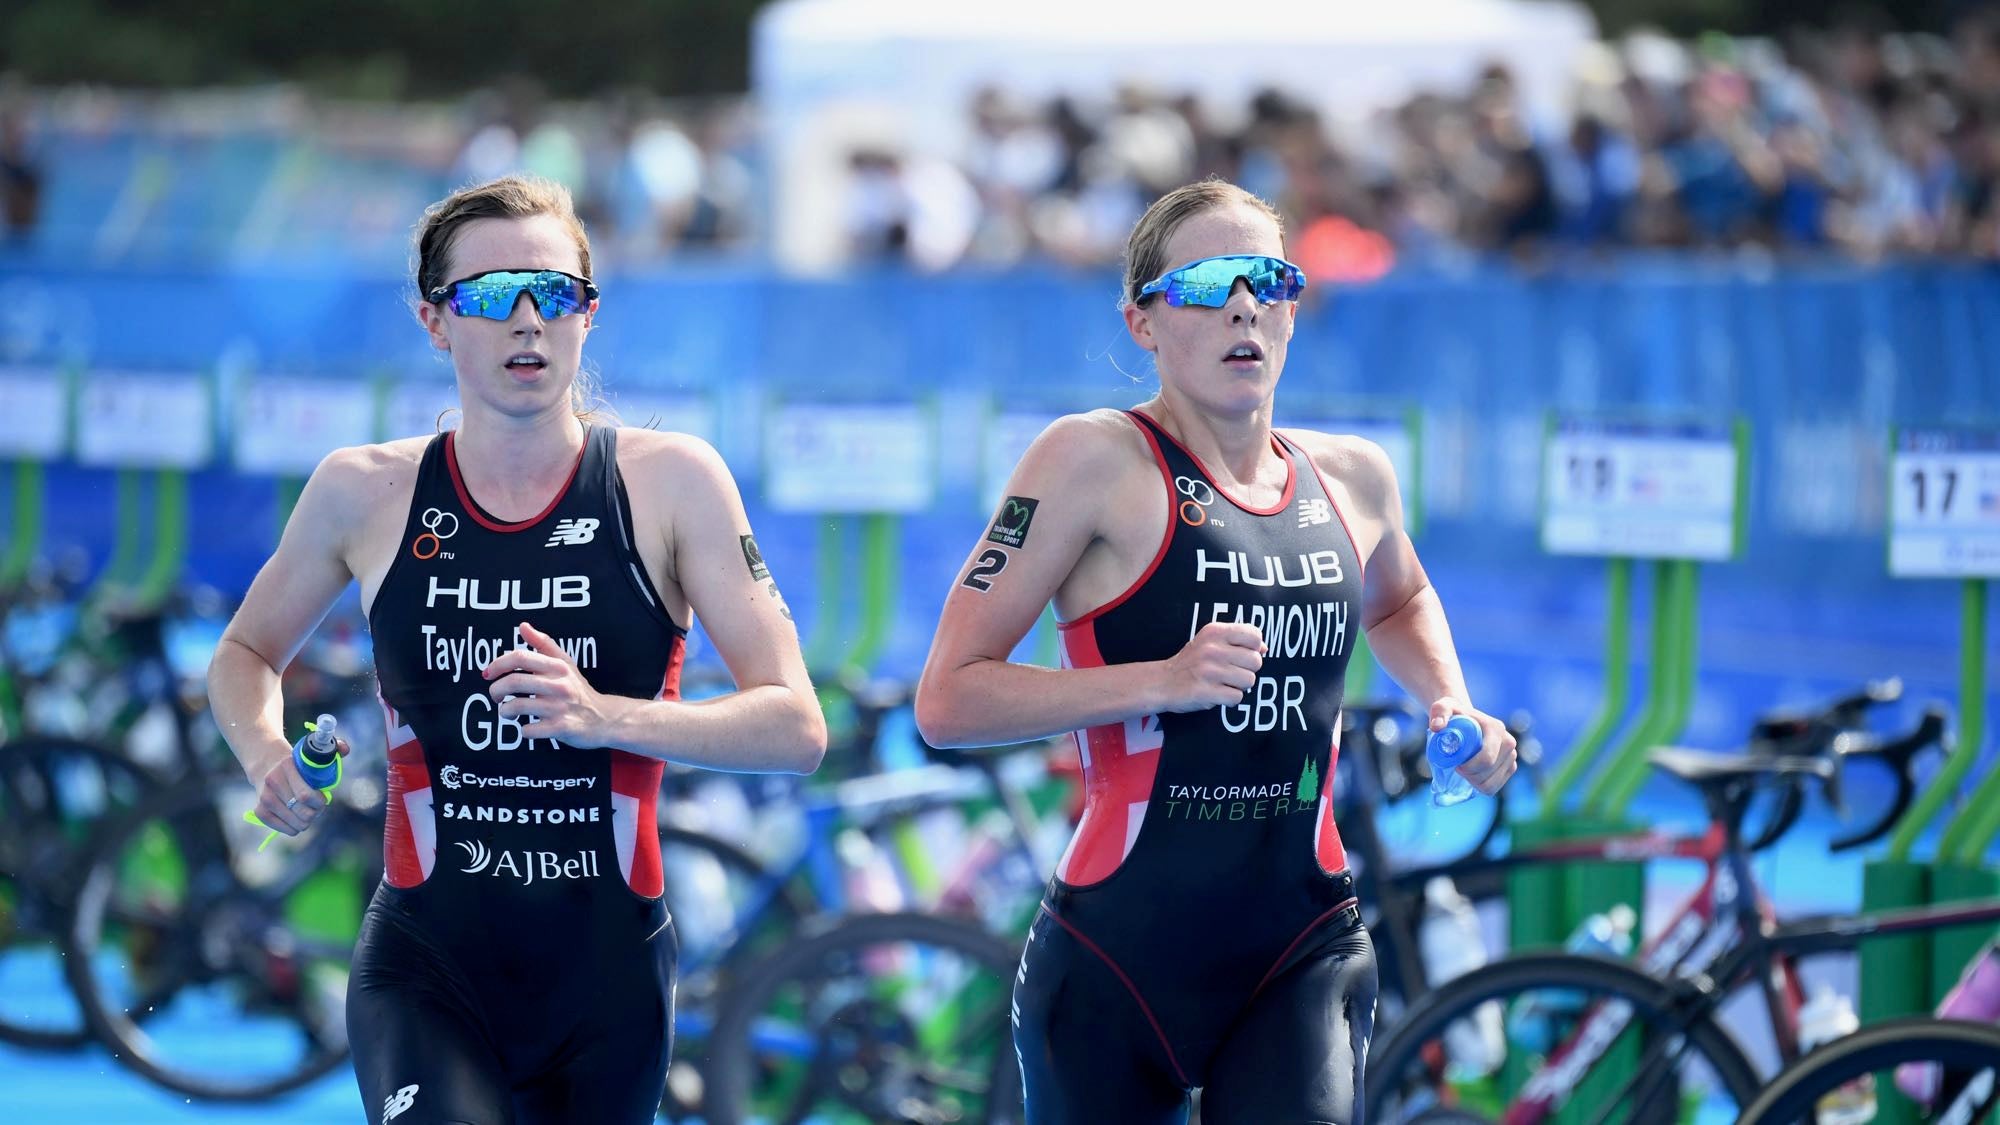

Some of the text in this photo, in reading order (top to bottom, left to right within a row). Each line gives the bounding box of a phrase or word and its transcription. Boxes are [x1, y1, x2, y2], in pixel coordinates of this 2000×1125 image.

[1911, 468, 1958, 514] 17
[544, 517, 600, 547] NB
[1211, 518, 1225, 527] ITU
[1003, 535, 1020, 545] SPORT
[439, 552, 455, 560] ITU
[1196, 549, 1344, 587] HUUB
[961, 547, 1009, 593] 2
[426, 576, 591, 610] HUUB
[421, 625, 597, 683] Taylor-wn
[1221, 675, 1307, 733] GBR
[461, 772, 597, 791] CycleSurgery
[1169, 782, 1292, 800] TAYLORMADE
[443, 803, 600, 824] SANDSTONE
[1166, 798, 1290, 821] TIMBER
